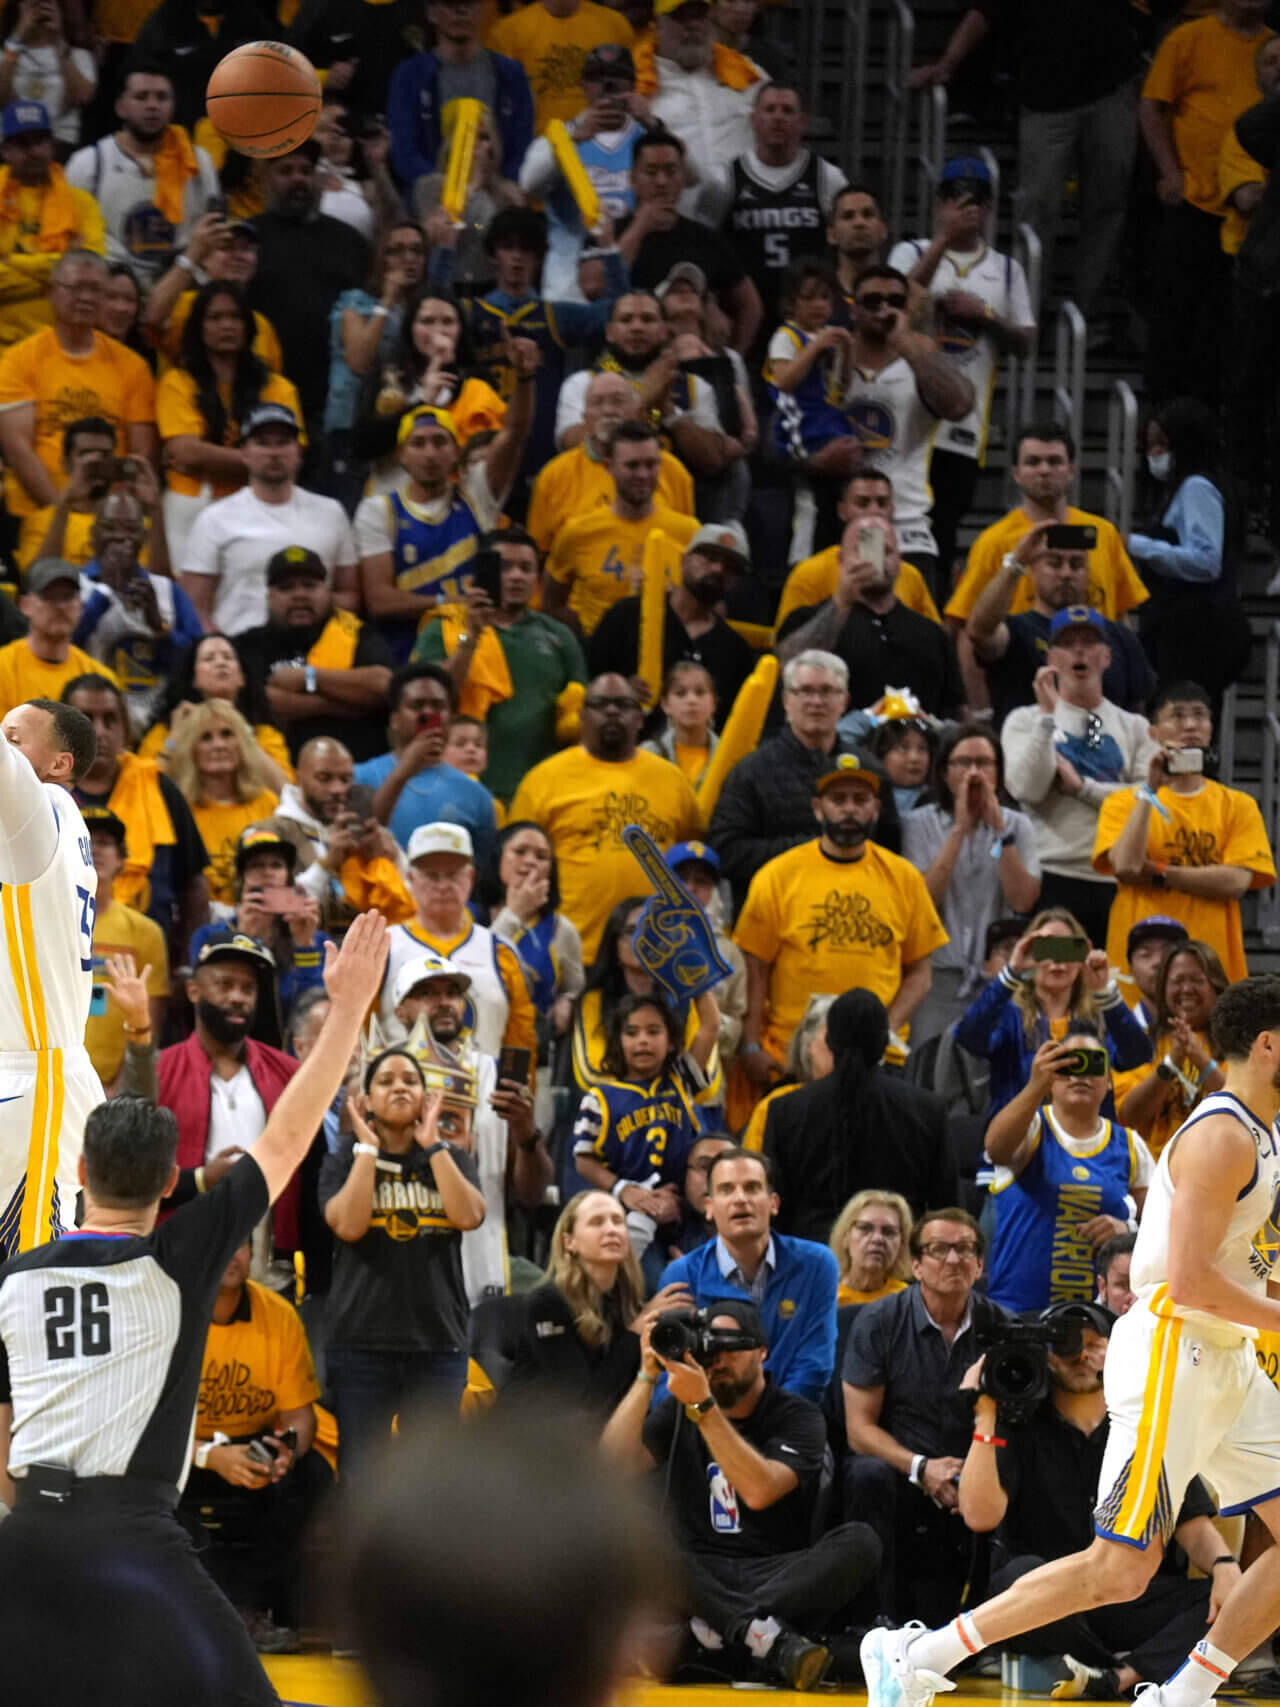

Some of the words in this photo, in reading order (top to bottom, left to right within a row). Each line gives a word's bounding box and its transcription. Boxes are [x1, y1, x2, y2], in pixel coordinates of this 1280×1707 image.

[735, 207, 819, 229] KINGS
[764, 233, 790, 268] 5
[1049, 1183, 1103, 1303] WARRIOR
[43, 1282, 112, 1361] 26
